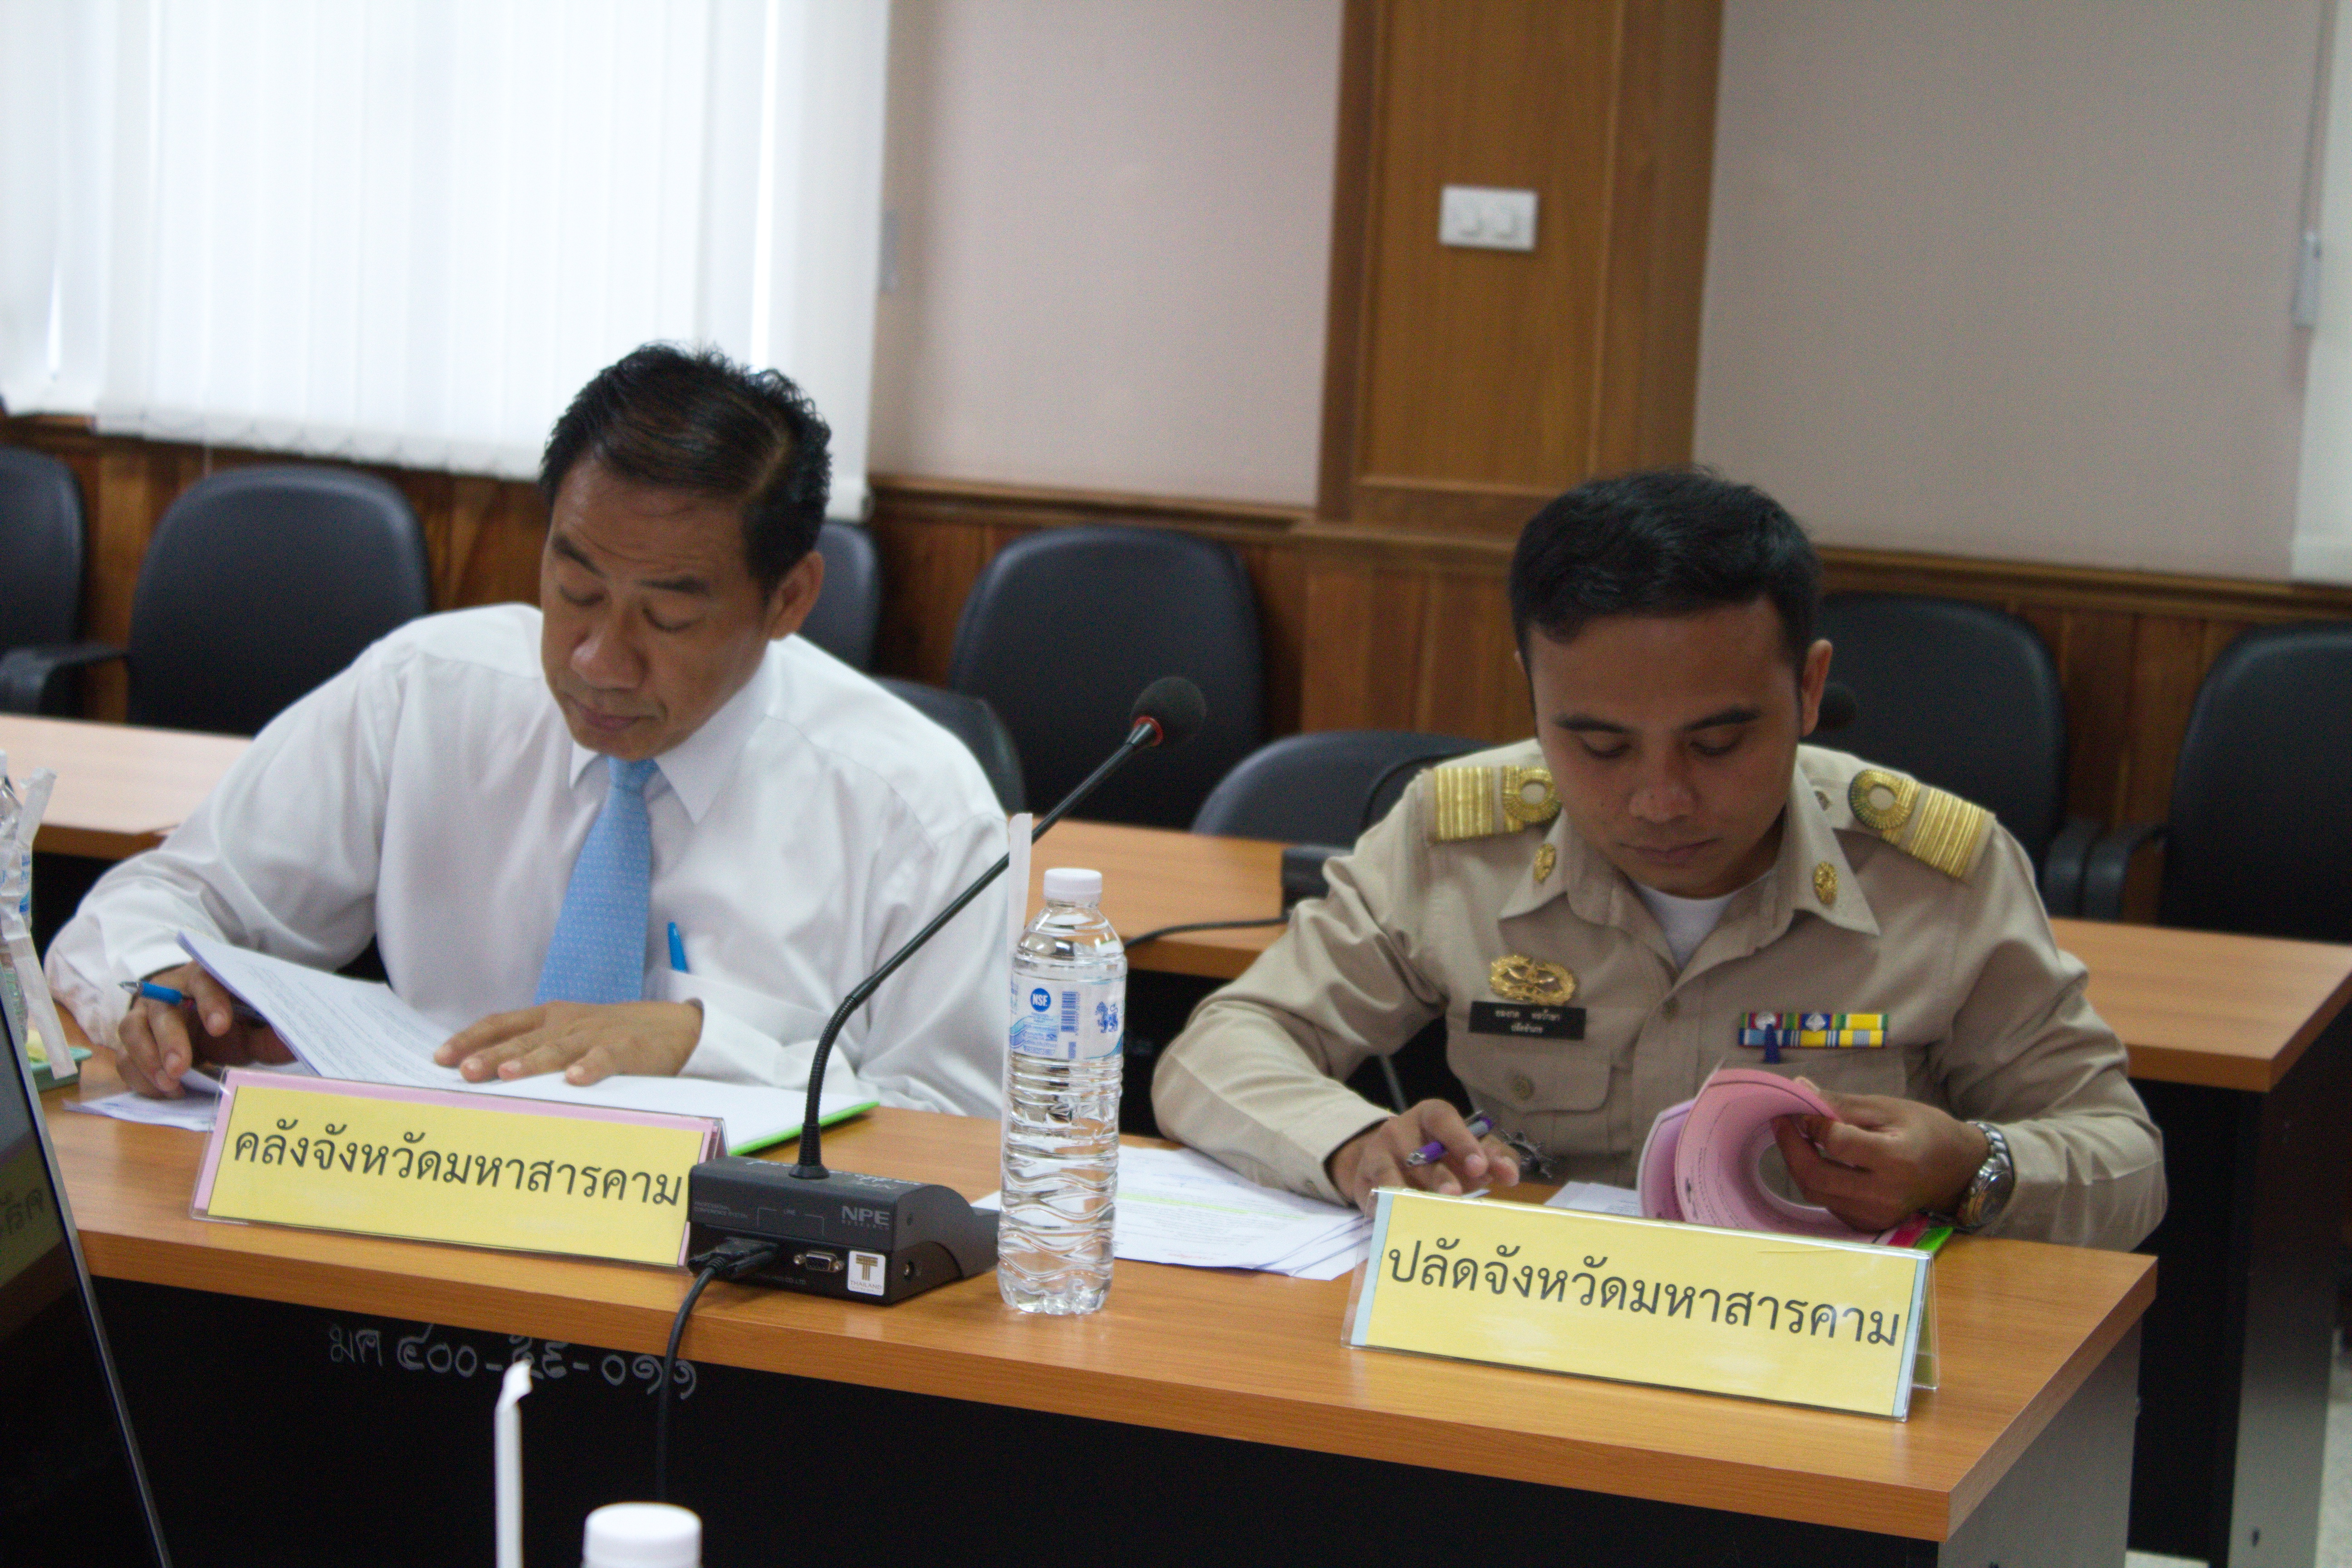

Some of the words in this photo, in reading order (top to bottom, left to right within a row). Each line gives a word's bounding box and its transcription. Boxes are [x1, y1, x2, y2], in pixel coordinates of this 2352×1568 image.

[1032, 993, 1049, 1006] NSF
[234, 1118, 682, 1206] คลังจังหวัดมหาสารคาม
[842, 1205, 890, 1226] NPE
[850, 1280, 882, 1290] THAILAND
[1388, 1237, 1900, 1347] ปลัดจังหวัดมหาสารคาม
